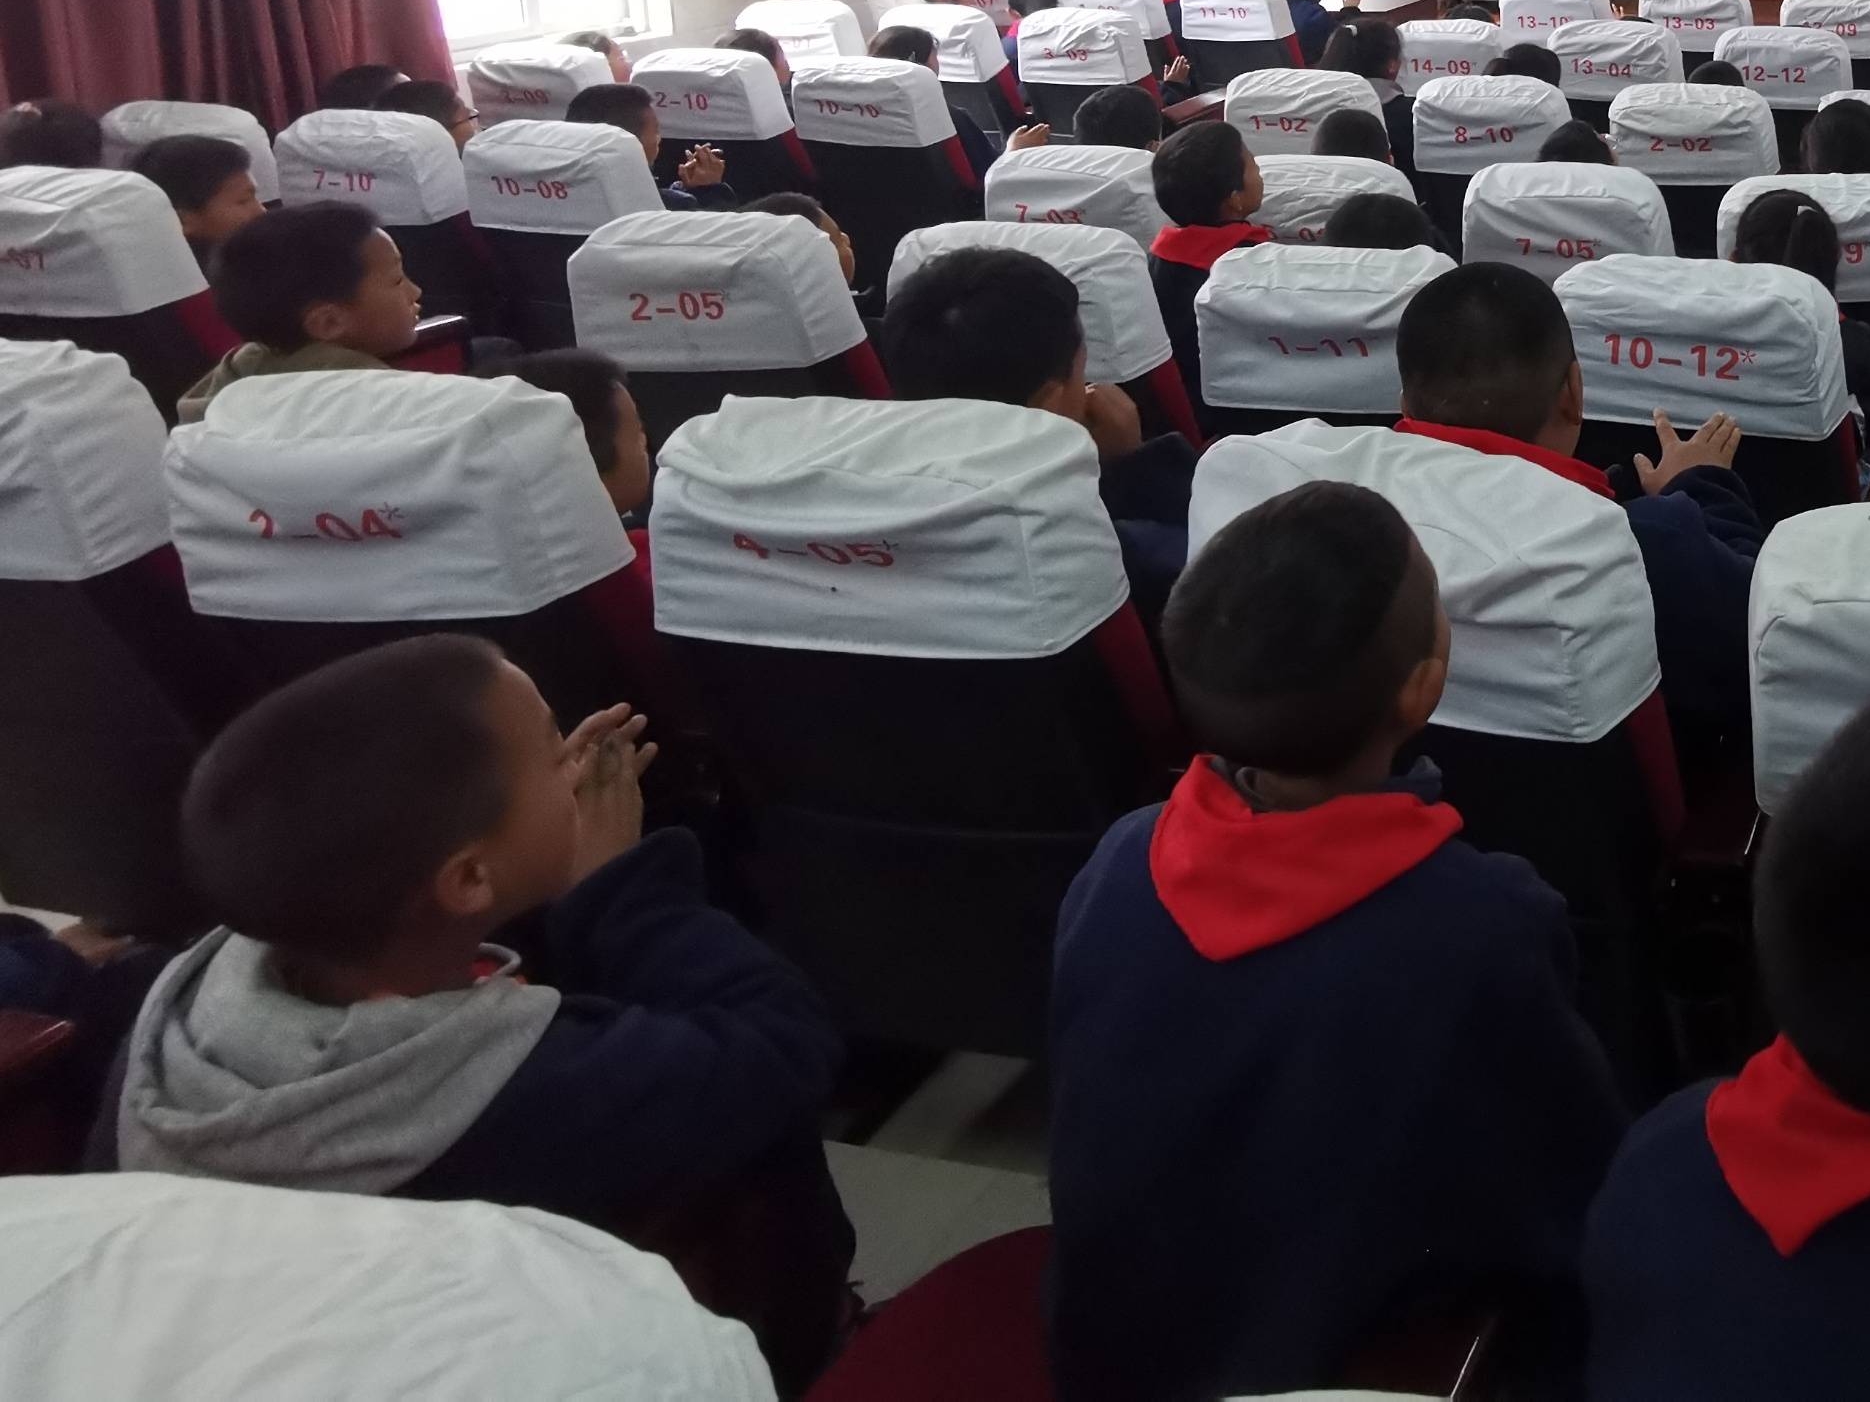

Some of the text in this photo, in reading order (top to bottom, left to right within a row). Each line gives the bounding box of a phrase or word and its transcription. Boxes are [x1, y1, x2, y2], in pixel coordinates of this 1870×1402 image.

[1200, 7, 1247, 19] 11-10
[1517, 15, 1568, 29] 13-10
[1663, 16, 1716, 31] 13-03
[1411, 58, 1471, 75] 14-09
[1571, 58, 1632, 77] 13-04
[1742, 65, 1806, 83] 12-12
[655, 91, 709, 111] 2-10
[815, 100, 881, 119] 10-10
[1250, 115, 1308, 133] 1-02
[1455, 126, 1513, 144] 8-10
[1649, 137, 1712, 152] 2-02
[312, 171, 372, 192] 7-10
[491, 175, 568, 200] 10-08
[1015, 204, 1082, 225] 7-03
[1516, 238, 1595, 260] 7-05
[630, 292, 724, 321] 2-05
[1268, 336, 1369, 358] 1-11
[1604, 334, 1741, 380] 10-12
[732, 532, 893, 568] 4-05
